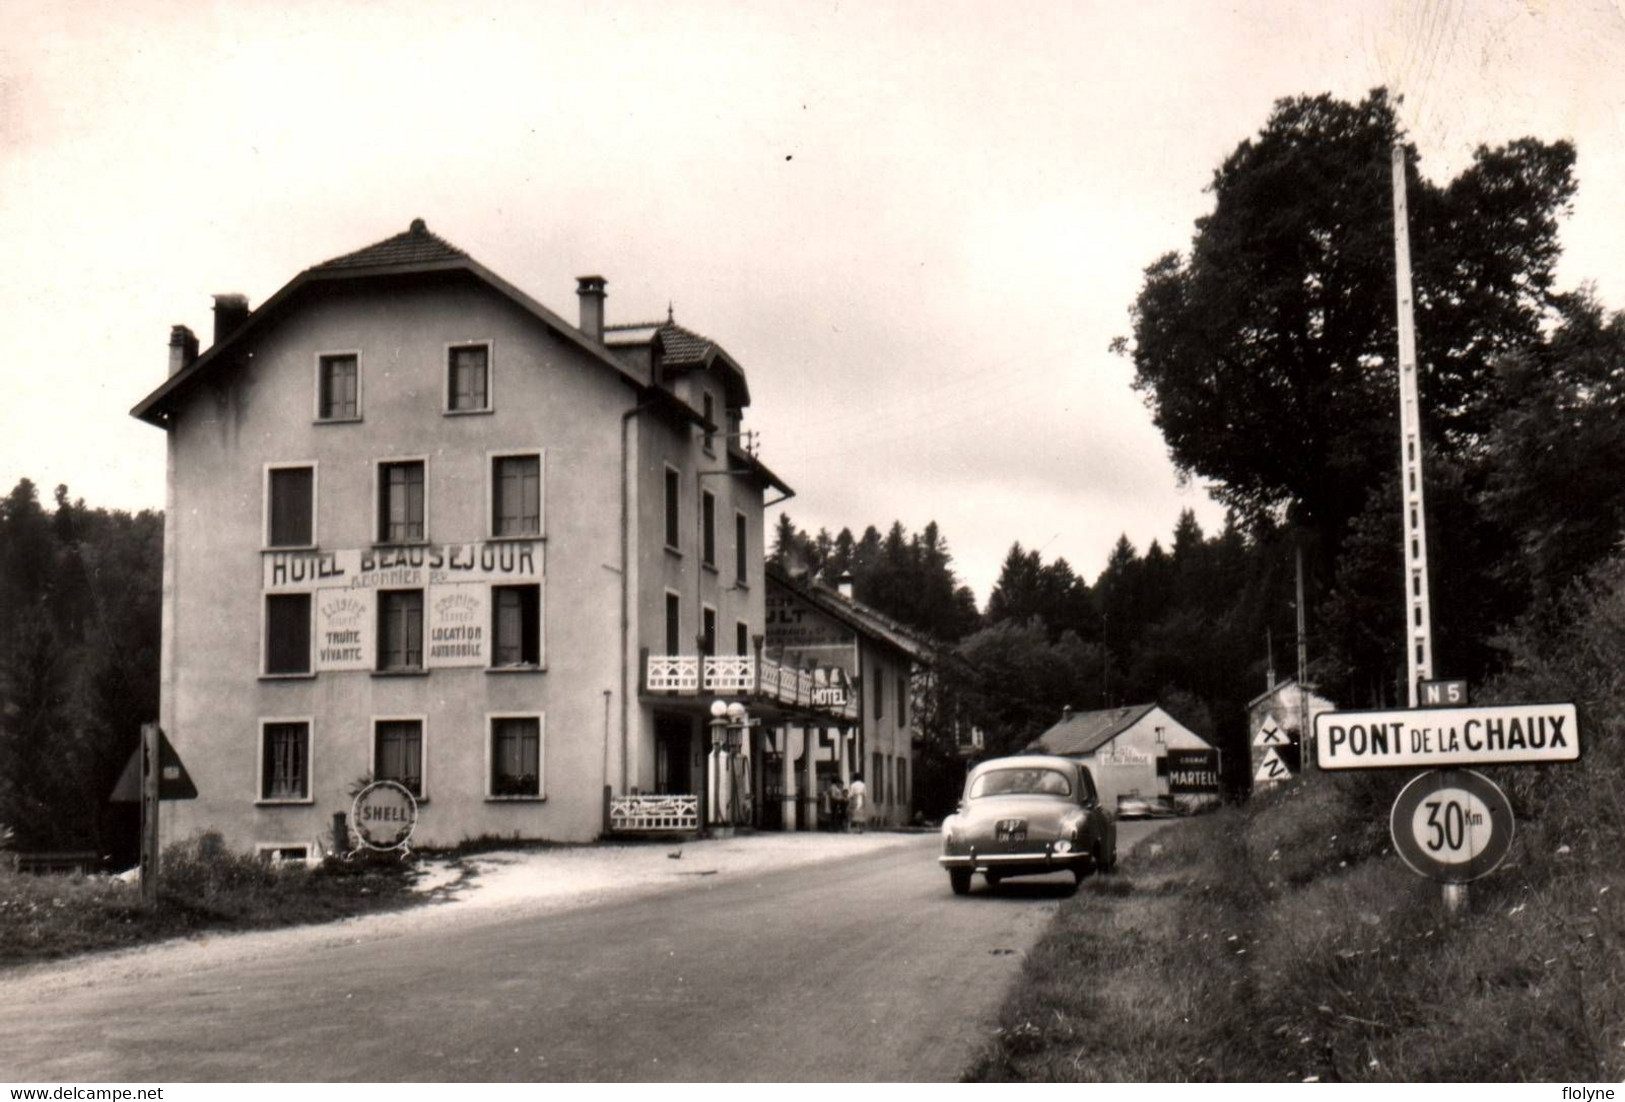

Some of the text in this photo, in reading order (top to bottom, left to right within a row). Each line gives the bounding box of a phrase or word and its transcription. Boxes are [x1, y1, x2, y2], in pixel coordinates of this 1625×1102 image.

[273, 552, 344, 585] HOTEL
[325, 629, 361, 644] TRUITE
[431, 625, 481, 641] LOCATION
[320, 647, 362, 662] VIVANTE
[430, 643, 481, 658] AUTOMOBILE
[811, 687, 847, 705] HOTEL
[1427, 685, 1460, 703] N 5
[1329, 715, 1568, 756] PONT DE LA CHAUX
[1169, 770, 1218, 786] MARTELL
[362, 806, 408, 822] SHELL
[1425, 801, 1483, 851] 30 Km
